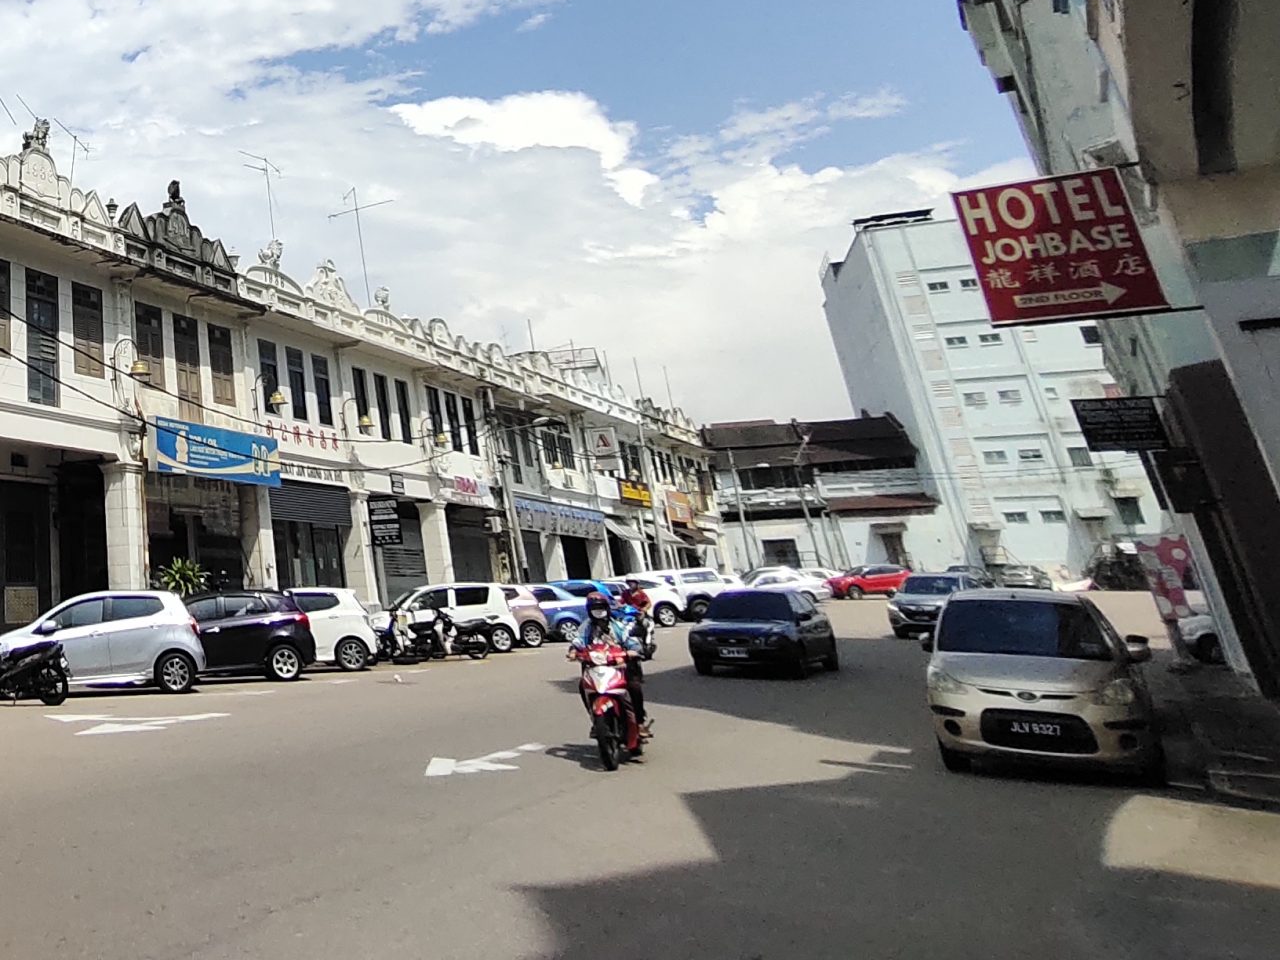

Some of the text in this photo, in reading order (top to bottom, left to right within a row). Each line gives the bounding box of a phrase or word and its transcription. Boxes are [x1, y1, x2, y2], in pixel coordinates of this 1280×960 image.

[959, 176, 1125, 235] HOTEL
[981, 223, 1134, 265] JOHBASE
[985, 253, 1147, 289] 龍祥酒店
[1020, 290, 1105, 305] 2ND FLOOR
